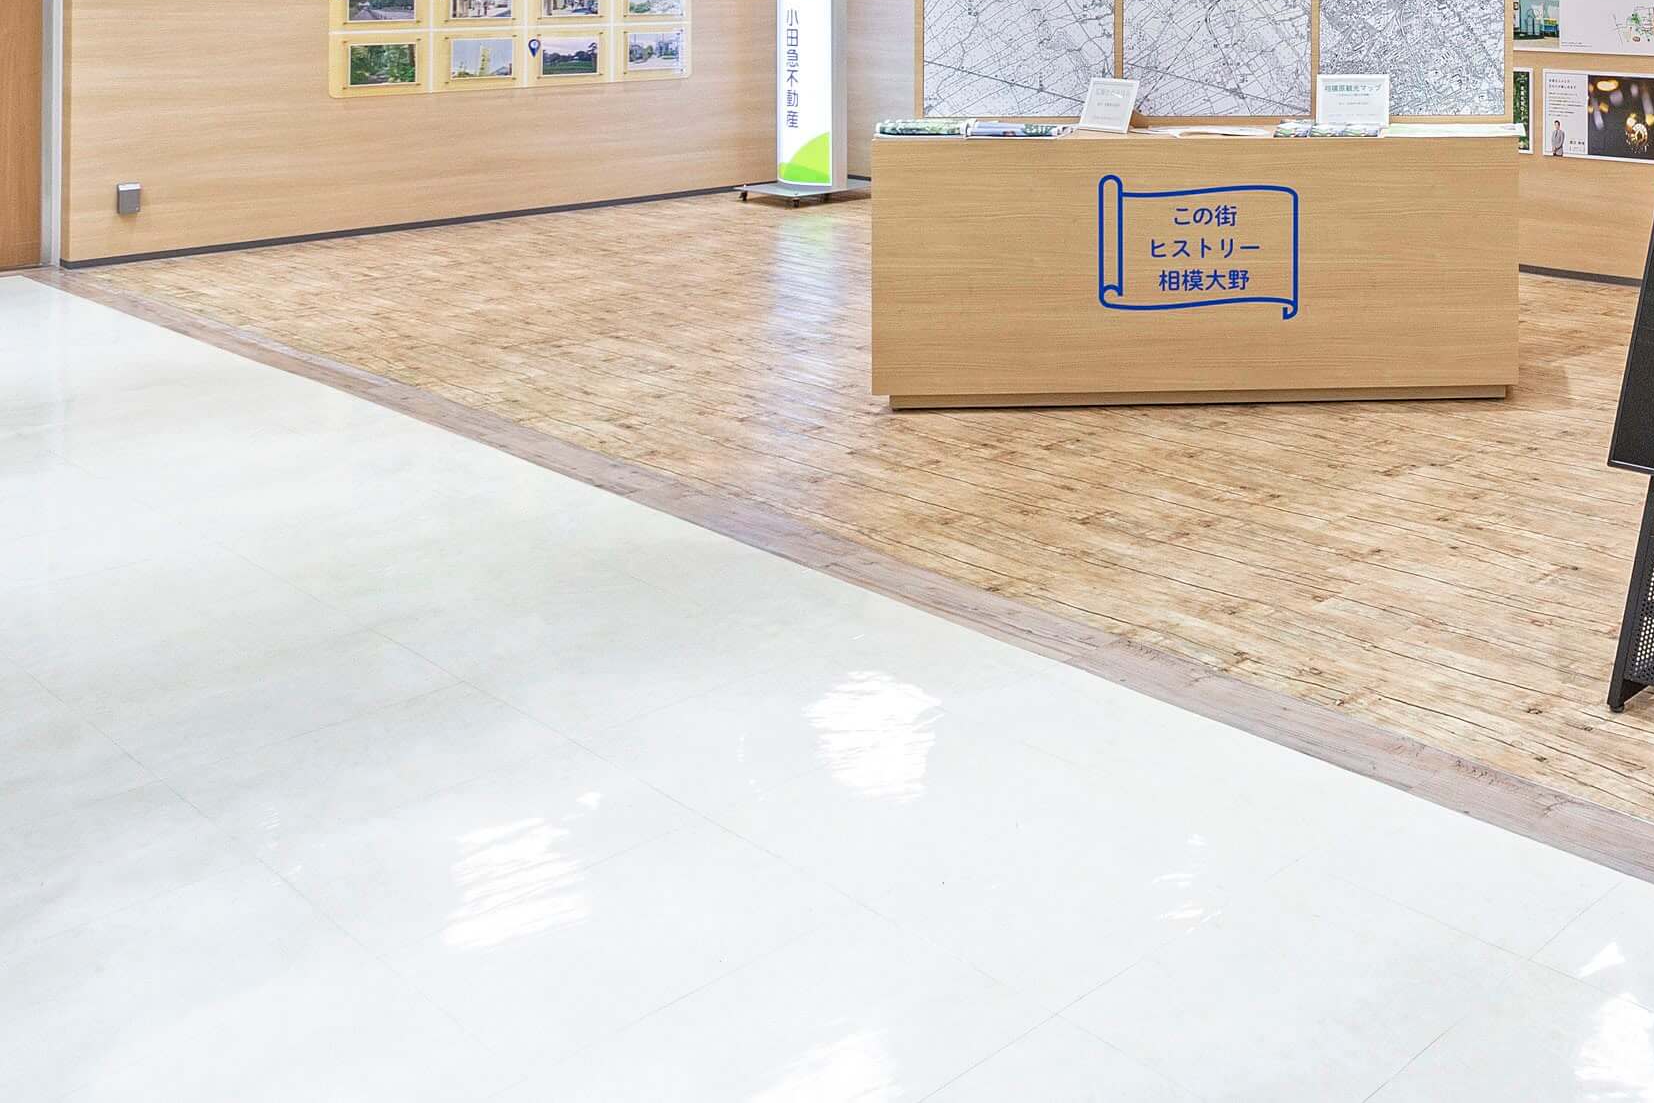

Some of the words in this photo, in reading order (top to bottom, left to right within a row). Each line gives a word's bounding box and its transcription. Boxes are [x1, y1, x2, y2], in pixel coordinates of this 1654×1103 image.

[786, 8, 799, 129] 小田急不動産
[1174, 205, 1237, 227] この街
[1150, 238, 1261, 259] ヒストリー
[1158, 269, 1250, 292] 相模大野
